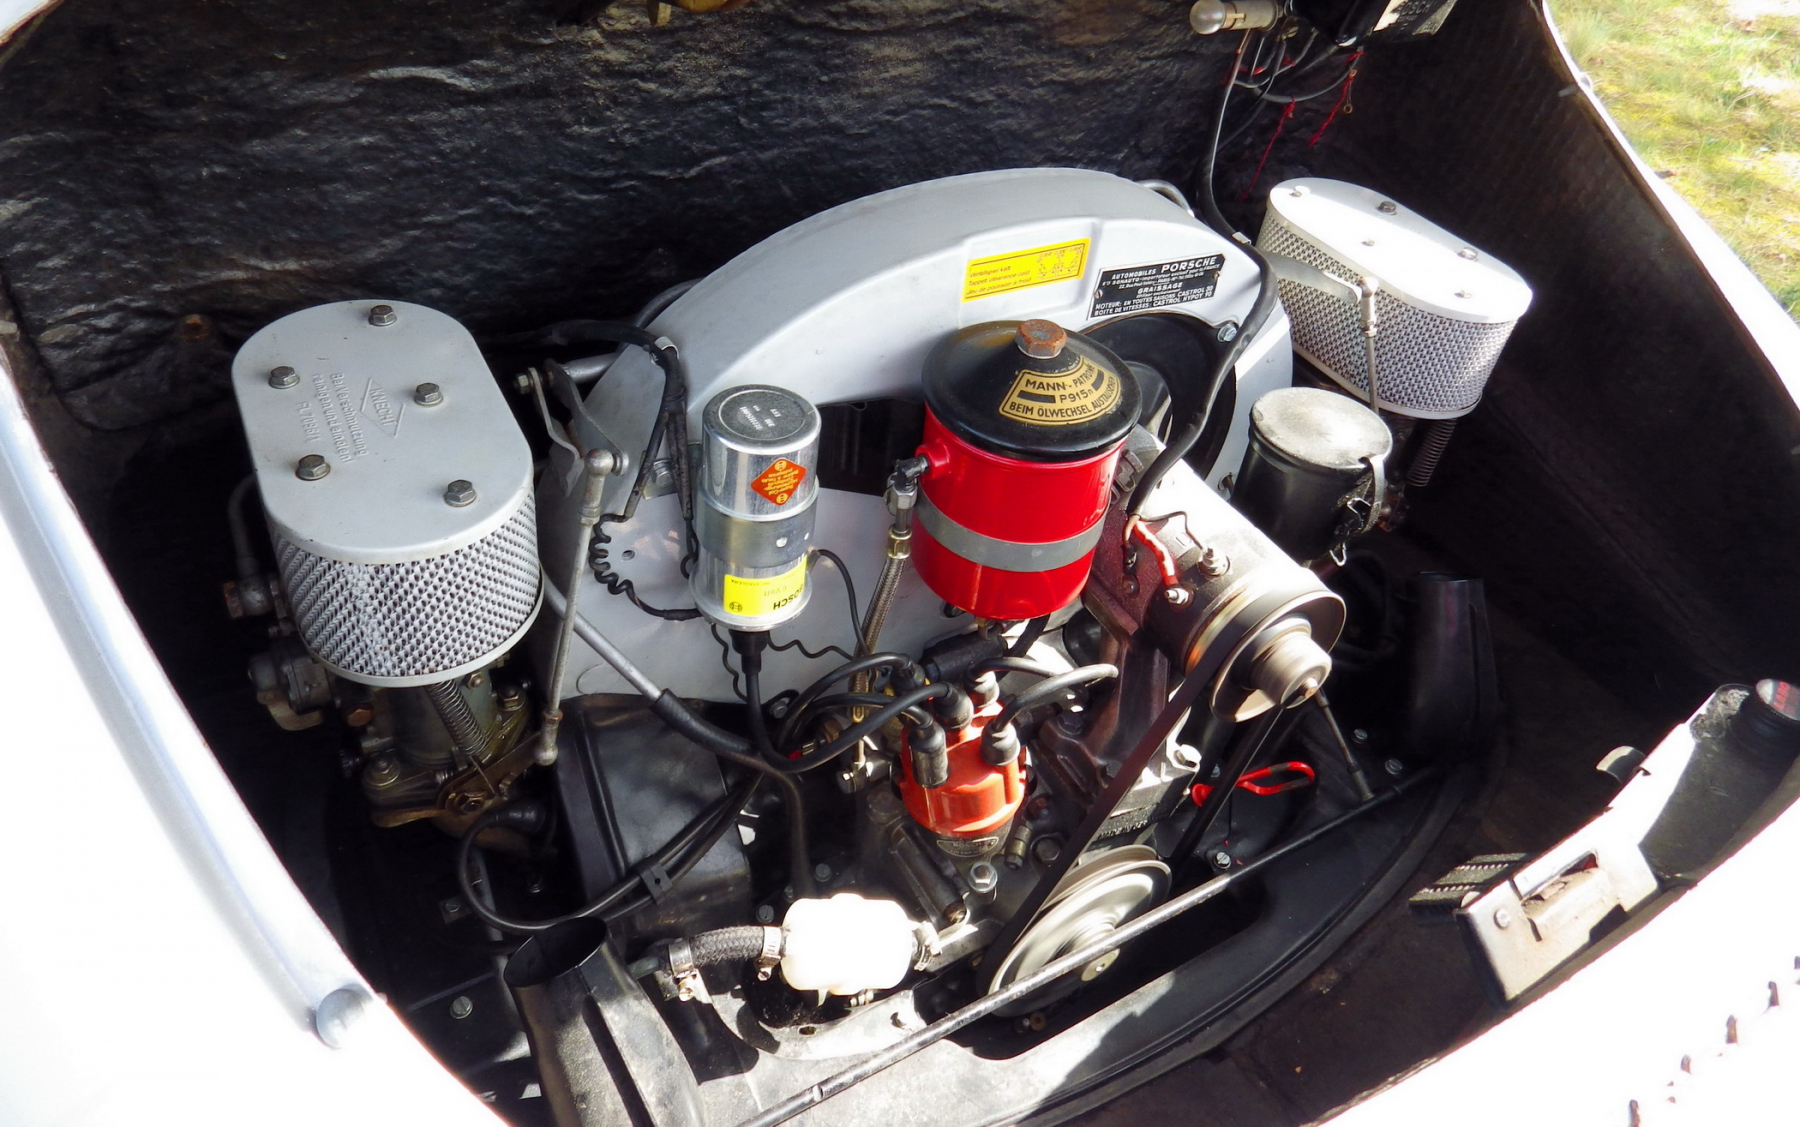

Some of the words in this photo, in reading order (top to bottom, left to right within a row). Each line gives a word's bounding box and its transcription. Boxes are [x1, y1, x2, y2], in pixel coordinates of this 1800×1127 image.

[1112, 270, 1157, 280] AUTOMOBILES
[1162, 257, 1218, 273] PORSCHE
[1138, 283, 1183, 294] GRAISSAGE
[1096, 302, 1122, 310] MOTEUR:
[1178, 289, 1205, 298] CASTROL
[1025, 378, 1067, 391] MANN
[369, 387, 398, 427] KNECHT
[1009, 401, 1034, 415] BEIM
[1037, 404, 1092, 418] ÖLWECHSEL
[323, 409, 342, 427] und
